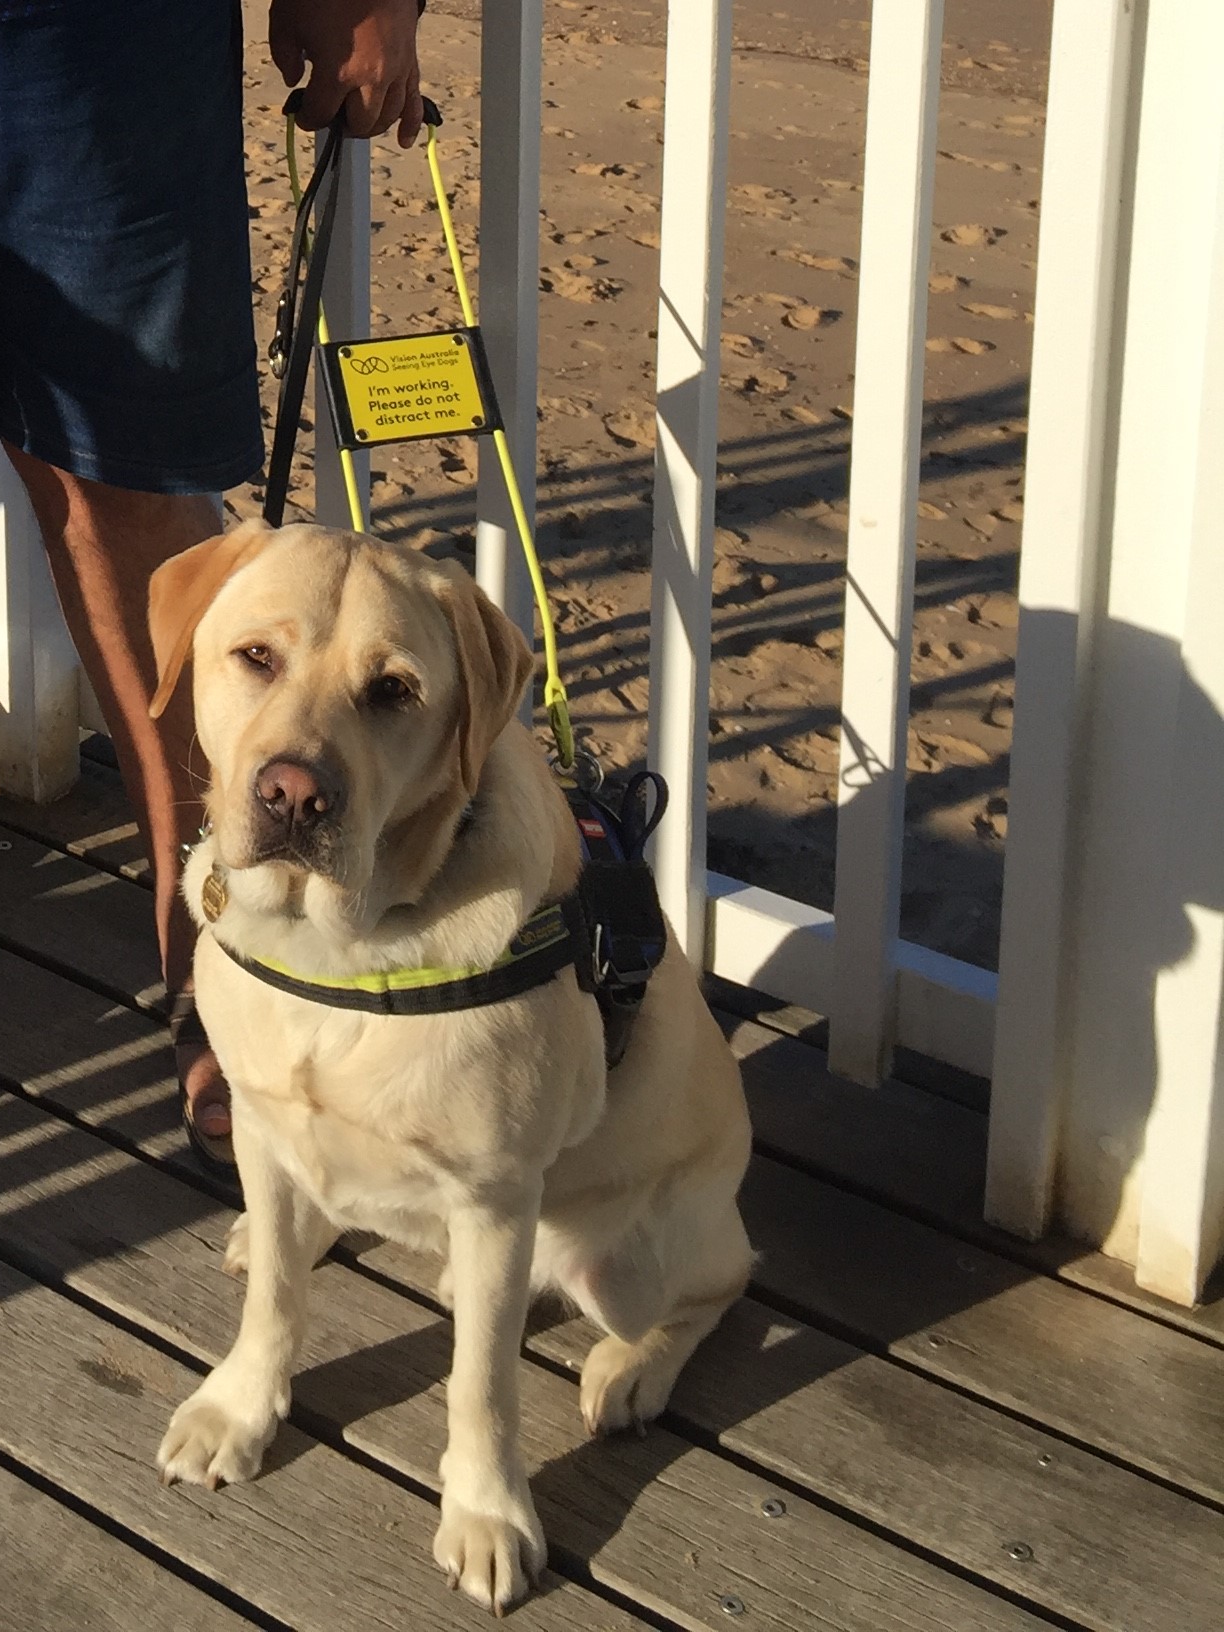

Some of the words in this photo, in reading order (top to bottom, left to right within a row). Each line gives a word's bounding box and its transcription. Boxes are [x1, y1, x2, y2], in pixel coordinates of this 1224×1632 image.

[390, 353, 418, 363] Vision
[419, 349, 460, 360] Australia
[392, 362, 420, 372] Seeing
[421, 360, 436, 369] Eye
[438, 357, 459, 367] Dogs
[368, 385, 390, 397] I'm
[393, 379, 454, 394] working.
[368, 399, 412, 412] Please
[415, 395, 433, 406] do
[436, 391, 461, 403] not
[375, 409, 431, 426] distract
[434, 408, 461, 419] me.
